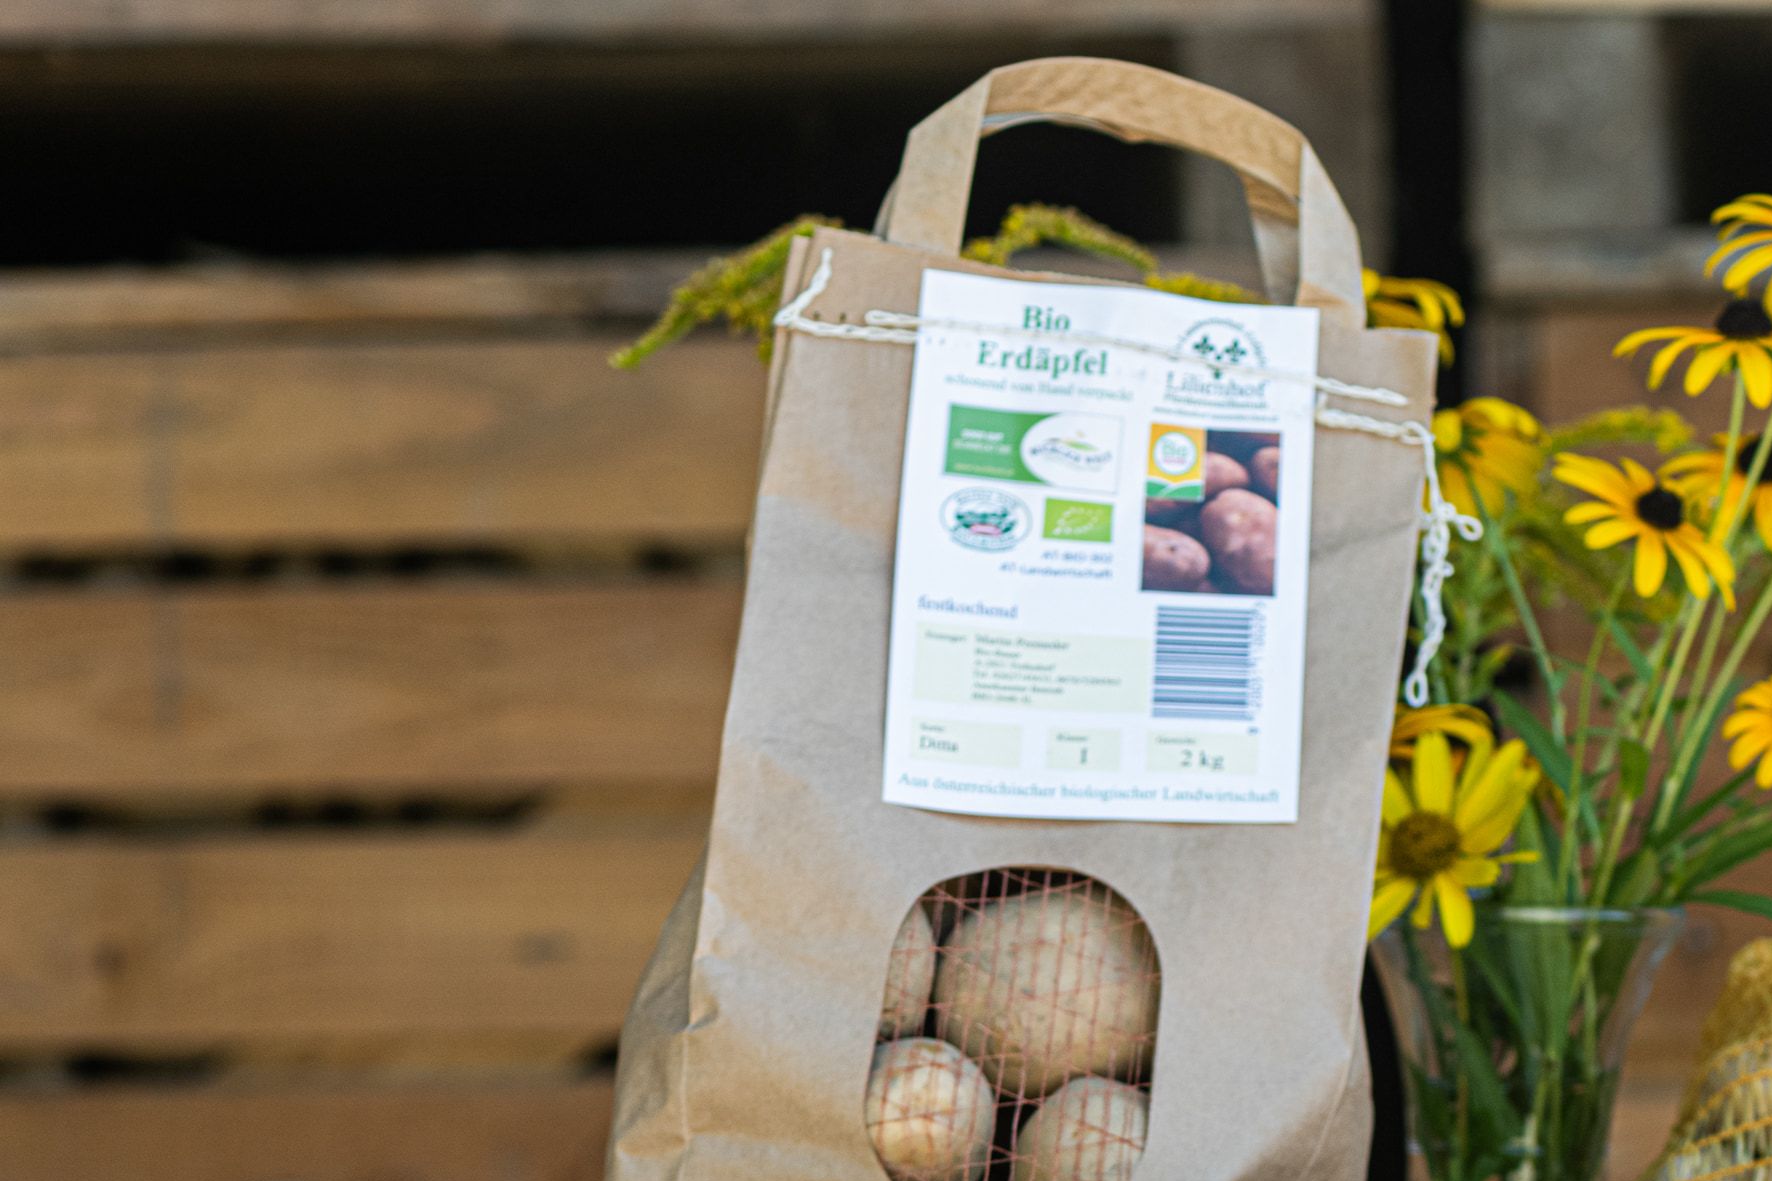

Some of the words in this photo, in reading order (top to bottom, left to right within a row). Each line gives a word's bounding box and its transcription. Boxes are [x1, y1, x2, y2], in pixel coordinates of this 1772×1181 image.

[1022, 305, 1071, 331] Bio
[977, 340, 1108, 379] Erdäpfel
[1180, 750, 1194, 767] 2
[1198, 751, 1225, 771] kg
[898, 773, 929, 788] Aus
[1060, 784, 1157, 802] biologischer
[1162, 786, 1281, 804] Landwirtschaft
